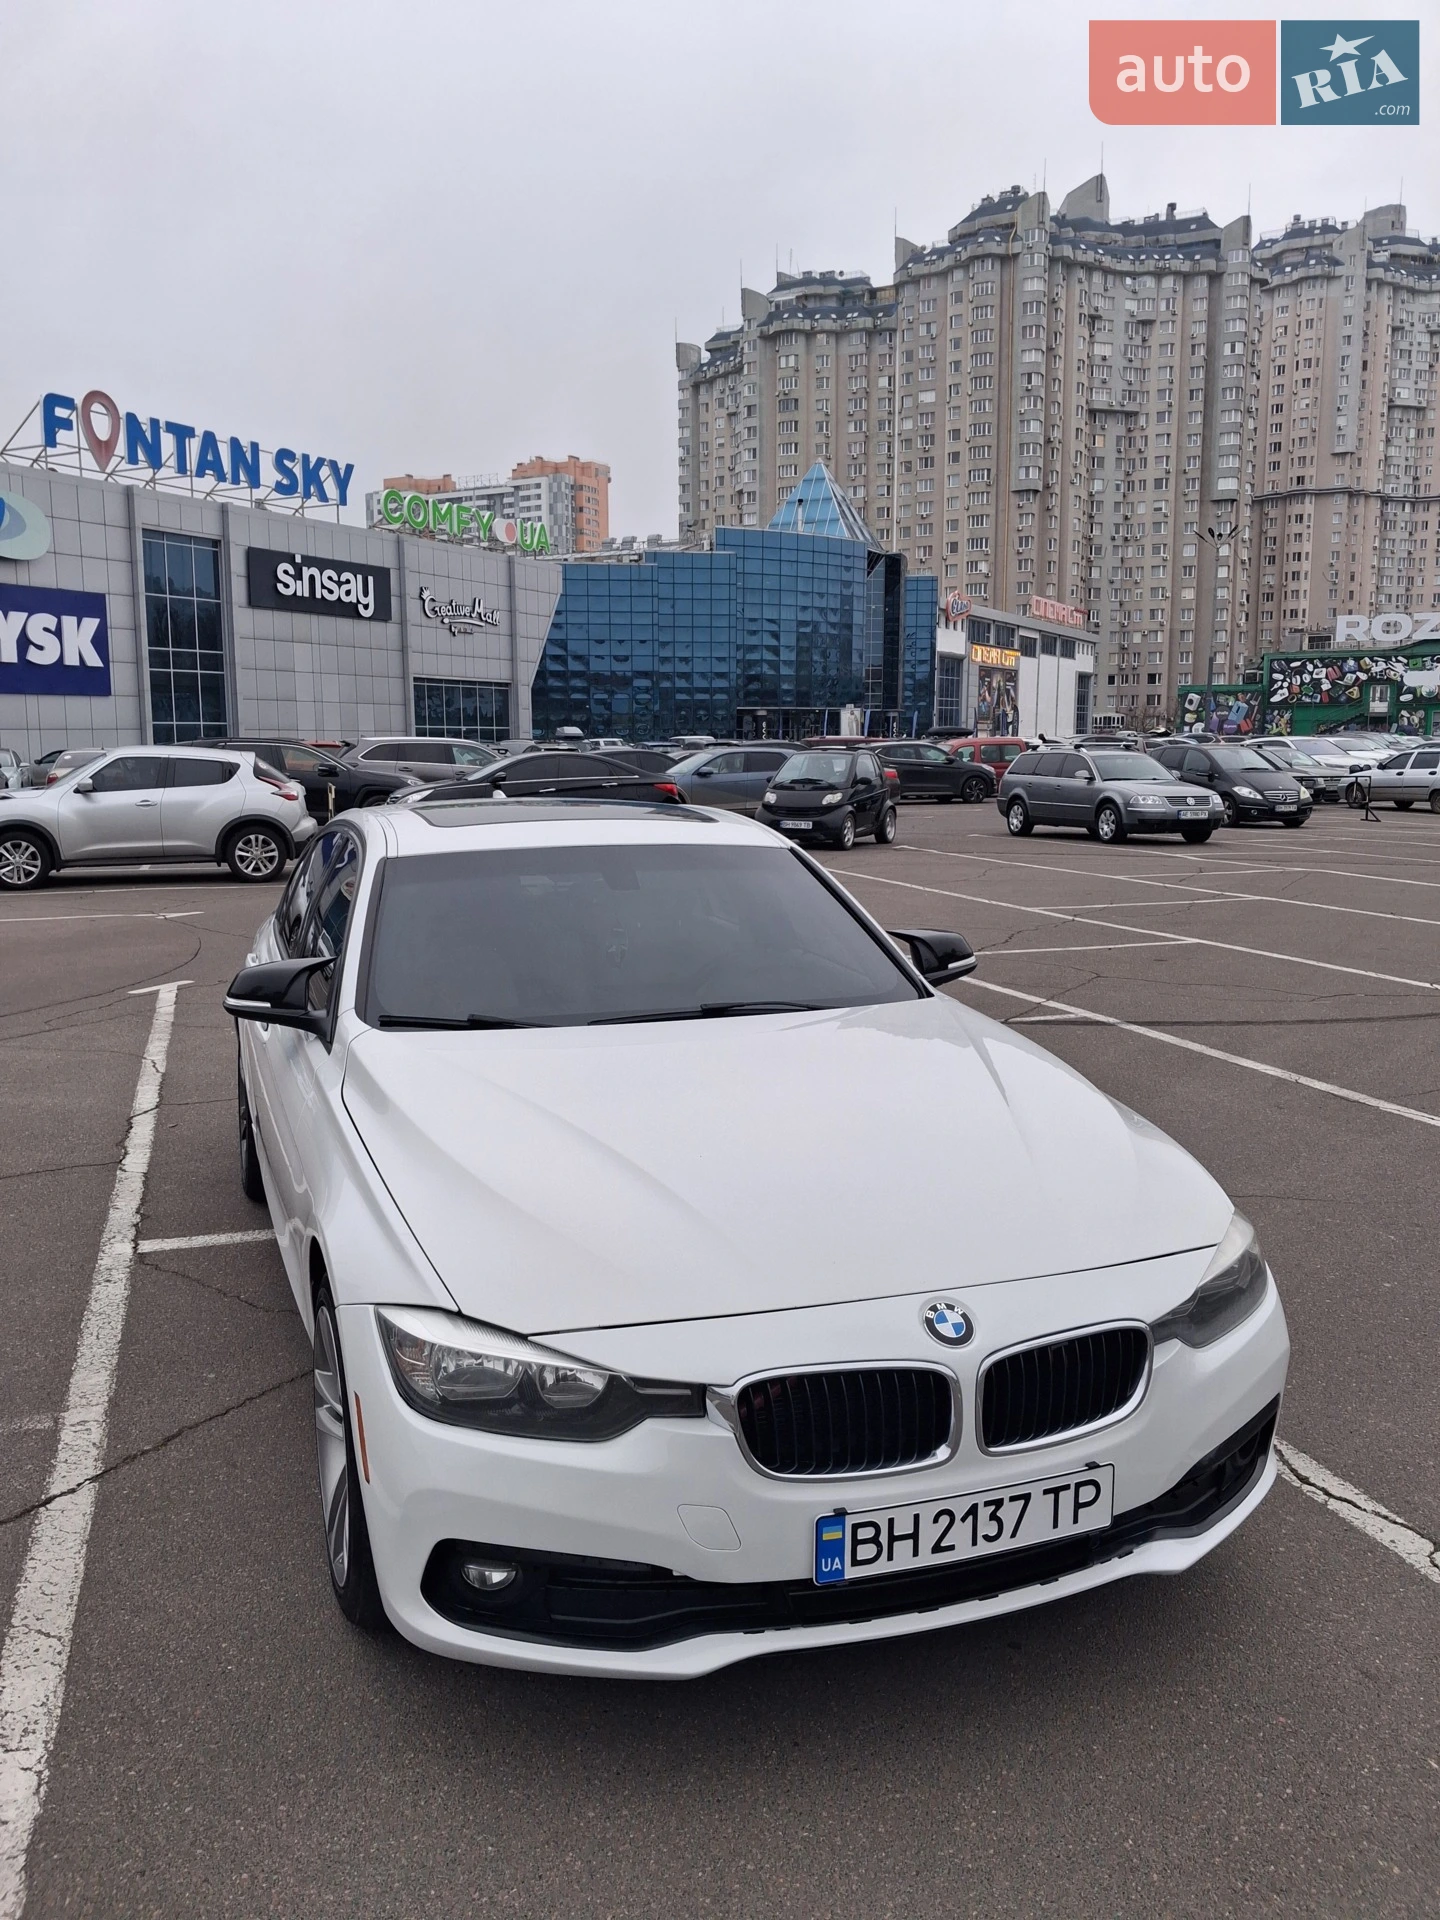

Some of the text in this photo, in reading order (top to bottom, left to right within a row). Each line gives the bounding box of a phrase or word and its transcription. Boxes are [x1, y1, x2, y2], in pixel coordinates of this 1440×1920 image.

[272, 447, 355, 507] SKY
[381, 488, 551, 554] COMFY UA
[276, 554, 375, 618] sinsay
[424, 595, 501, 626] Creative Mall
[926, 1302, 964, 1319] BMW
[821, 1478, 1103, 1572] UA BH 2137 TP
